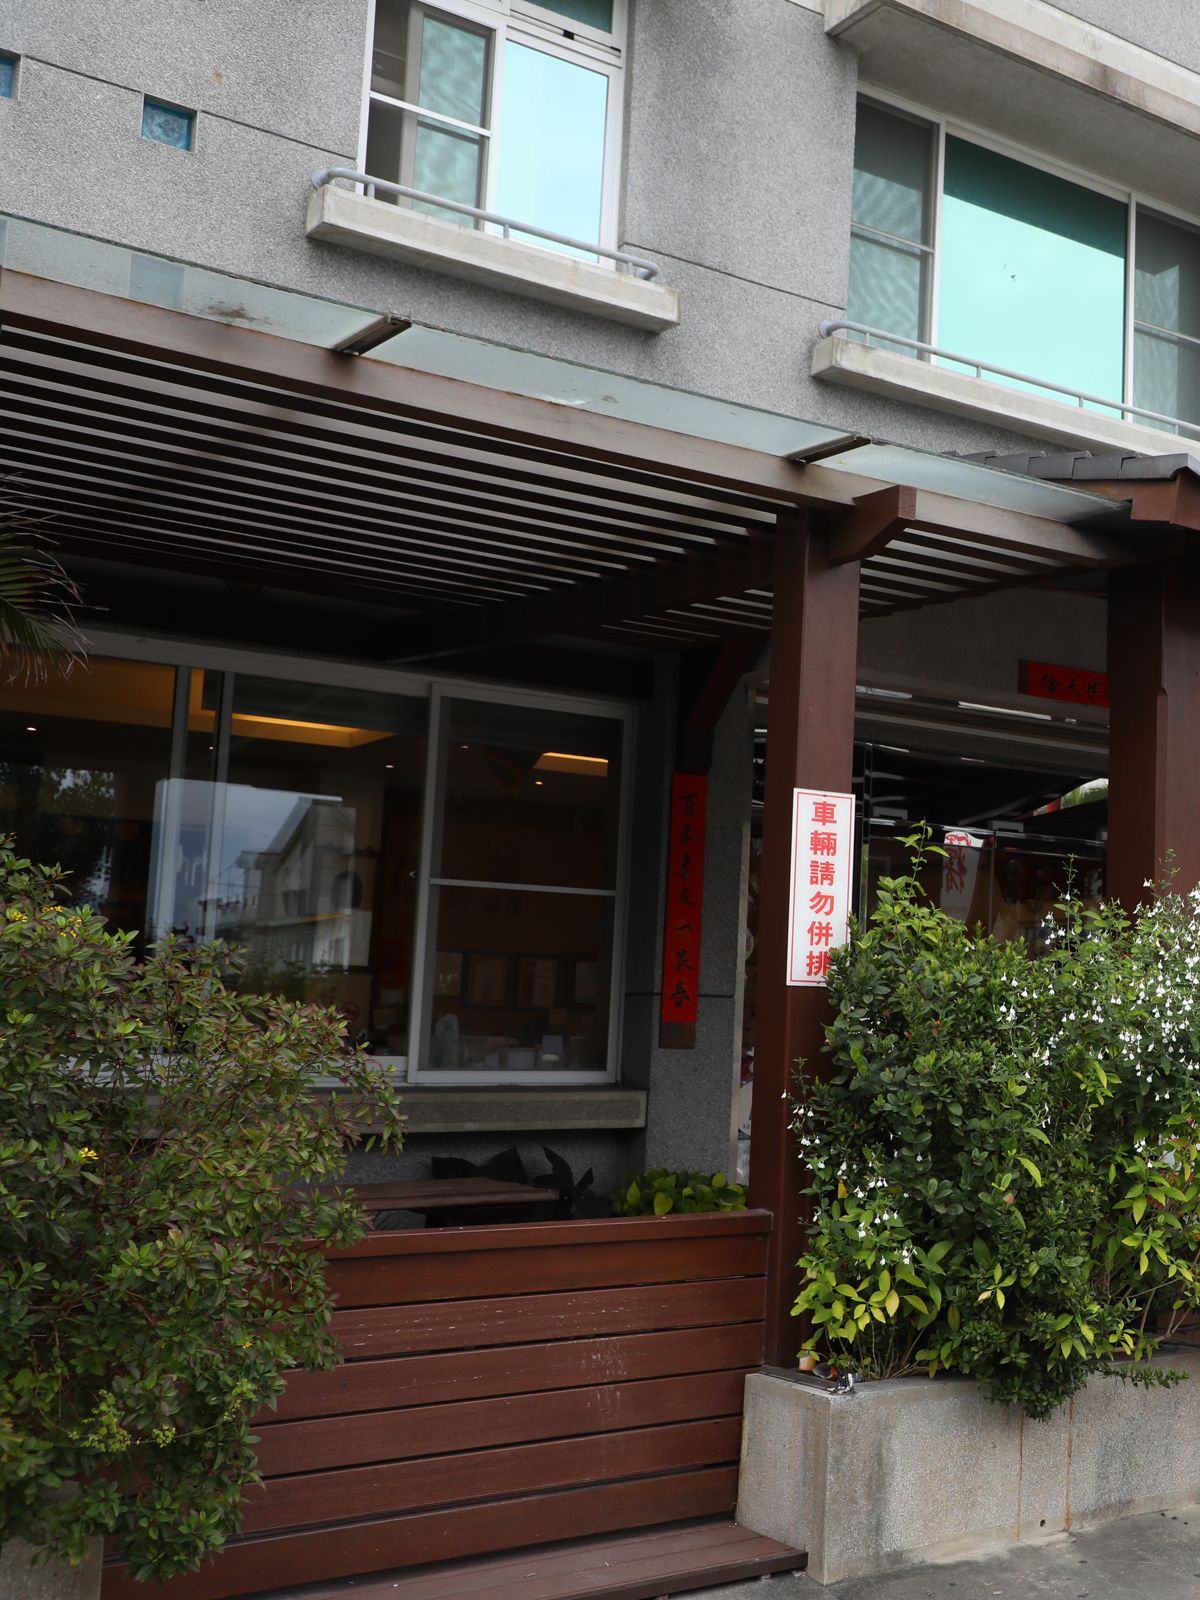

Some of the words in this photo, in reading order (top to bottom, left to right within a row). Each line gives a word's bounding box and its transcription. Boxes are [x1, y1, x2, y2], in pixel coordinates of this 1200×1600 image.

[805, 800, 838, 977] 車輛請勿併排
